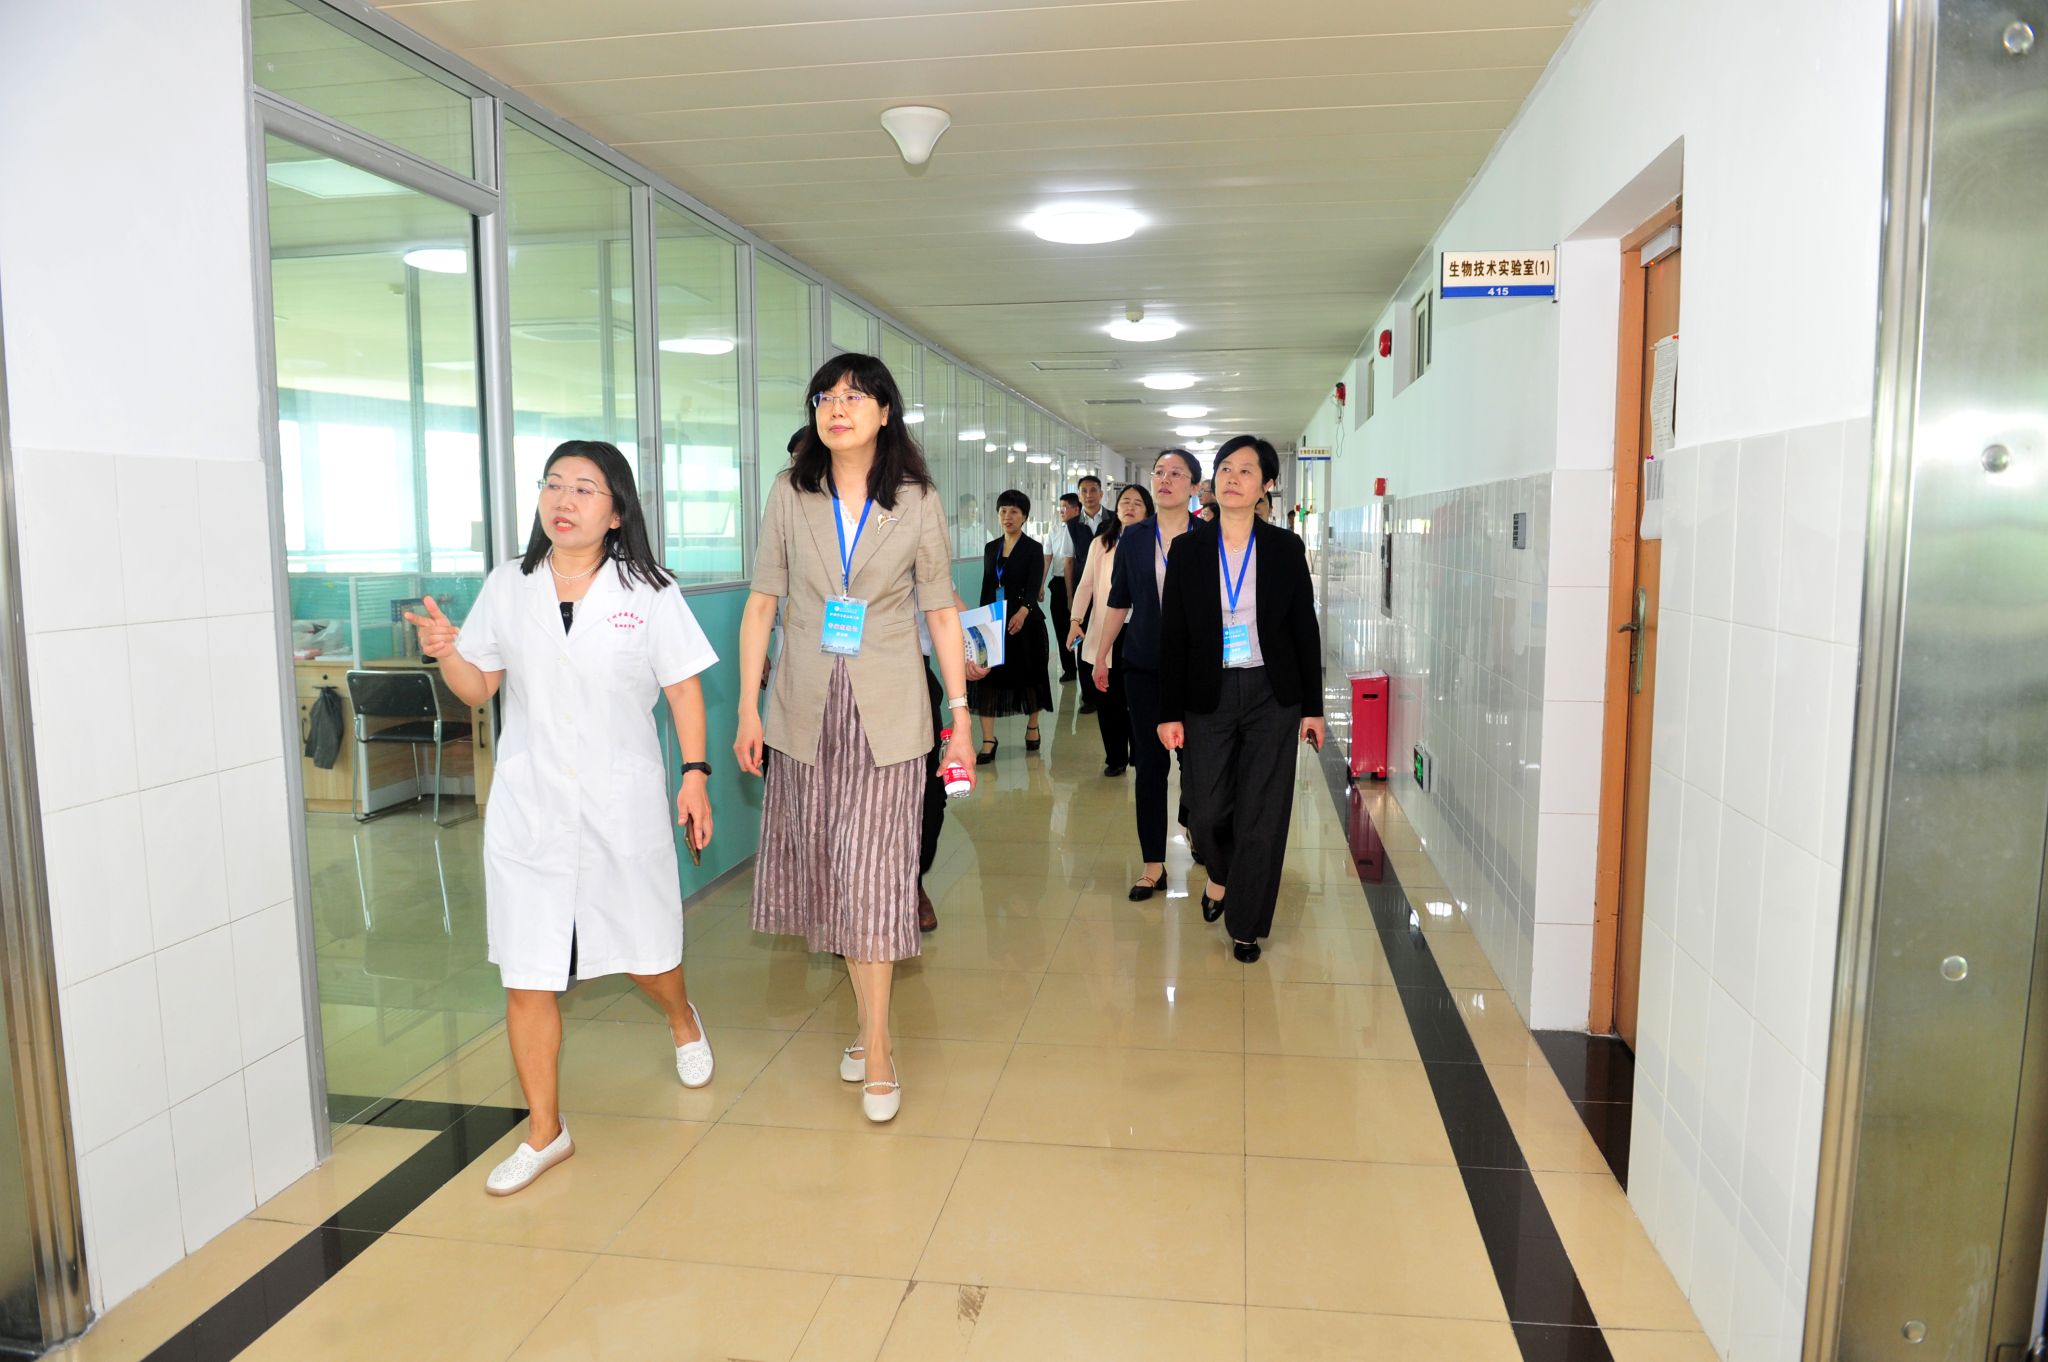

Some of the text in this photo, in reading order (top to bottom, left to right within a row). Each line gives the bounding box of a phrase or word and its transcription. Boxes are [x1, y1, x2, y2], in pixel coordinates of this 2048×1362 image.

[1449, 259, 1550, 278] 生物技术实验室(1)
[1488, 287, 1509, 296] 415
